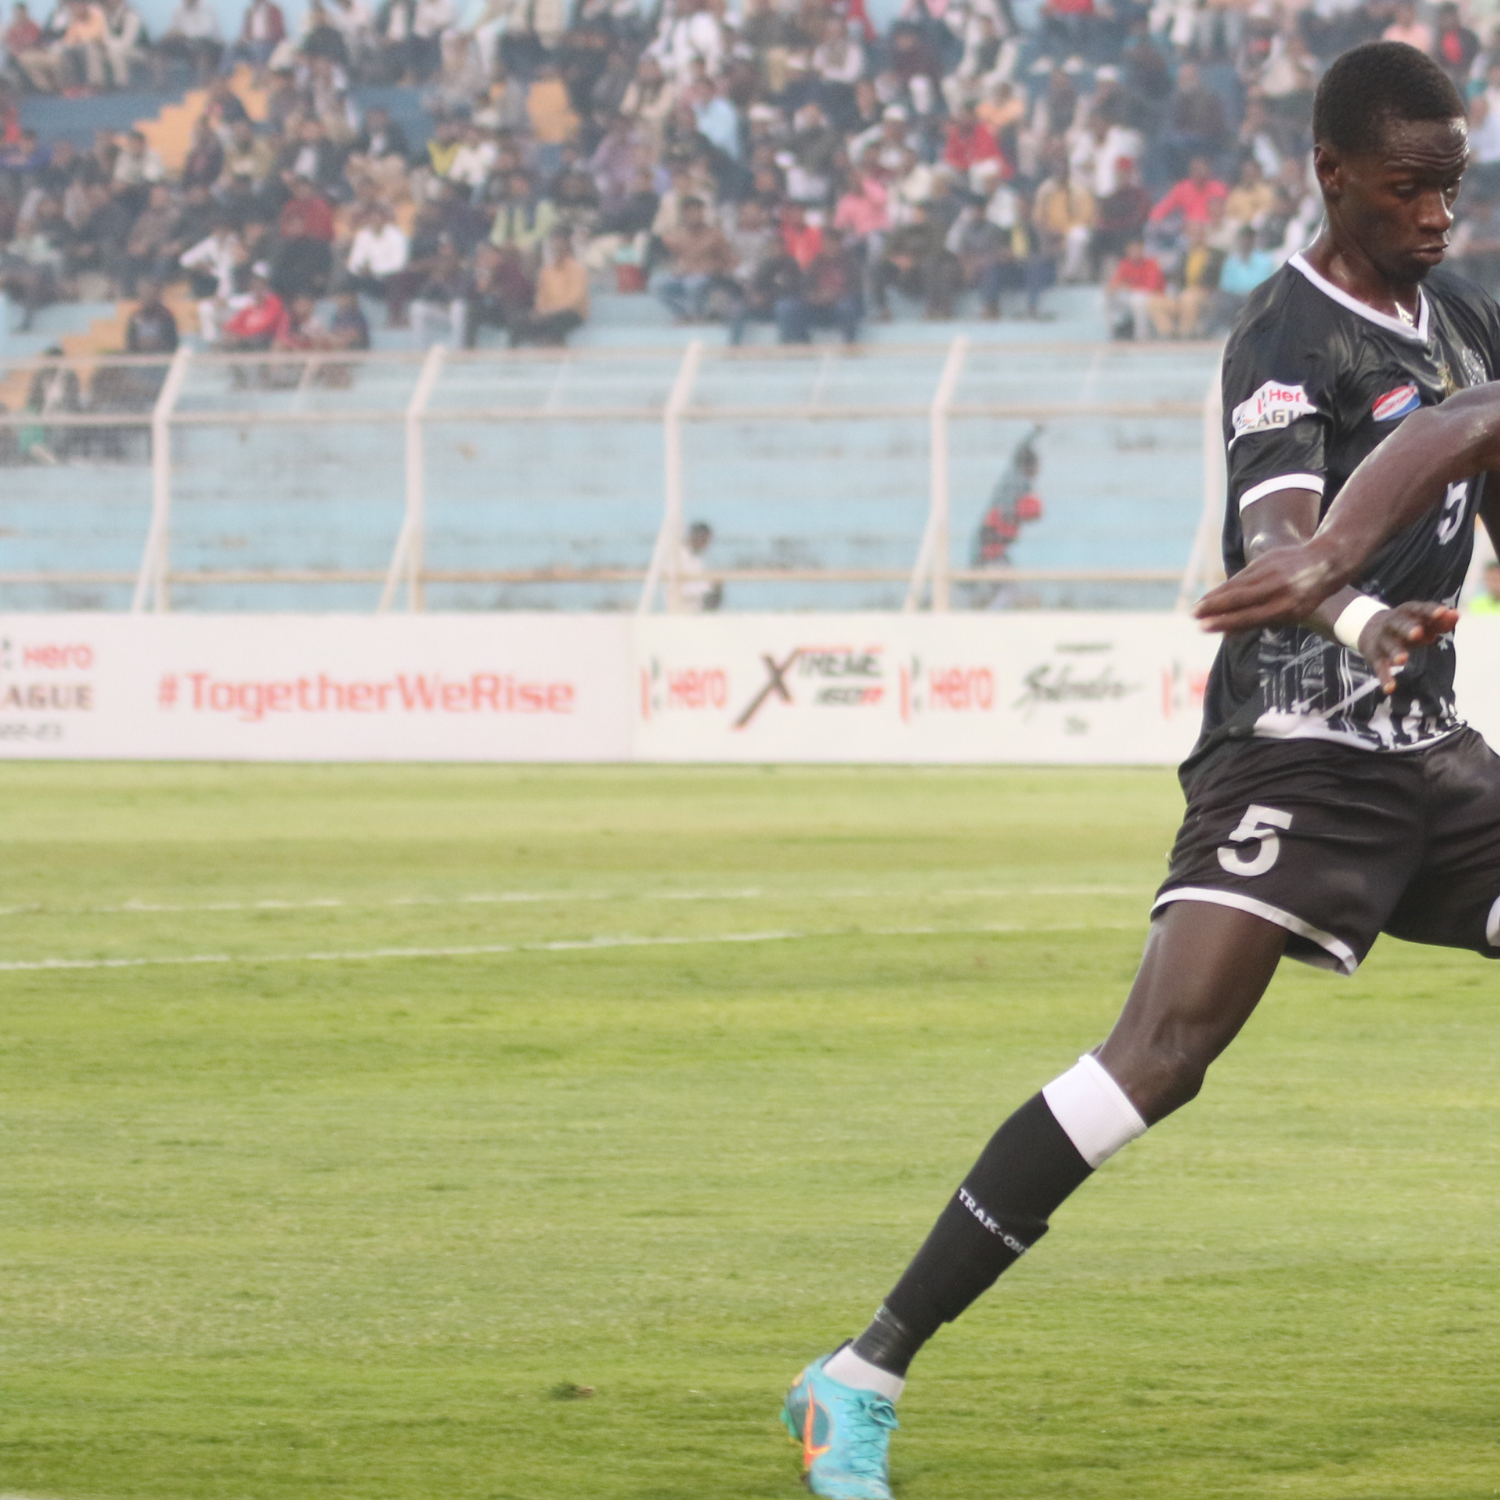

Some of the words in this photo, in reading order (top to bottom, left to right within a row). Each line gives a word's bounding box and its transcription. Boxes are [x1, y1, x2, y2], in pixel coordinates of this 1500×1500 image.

[1436, 481, 1468, 546] 5
[22, 642, 95, 671] Hero
[156, 669, 578, 724] #TogetherWeRise
[667, 667, 729, 709] Hero
[929, 666, 994, 711] Hero
[1217, 803, 1294, 877] 5
